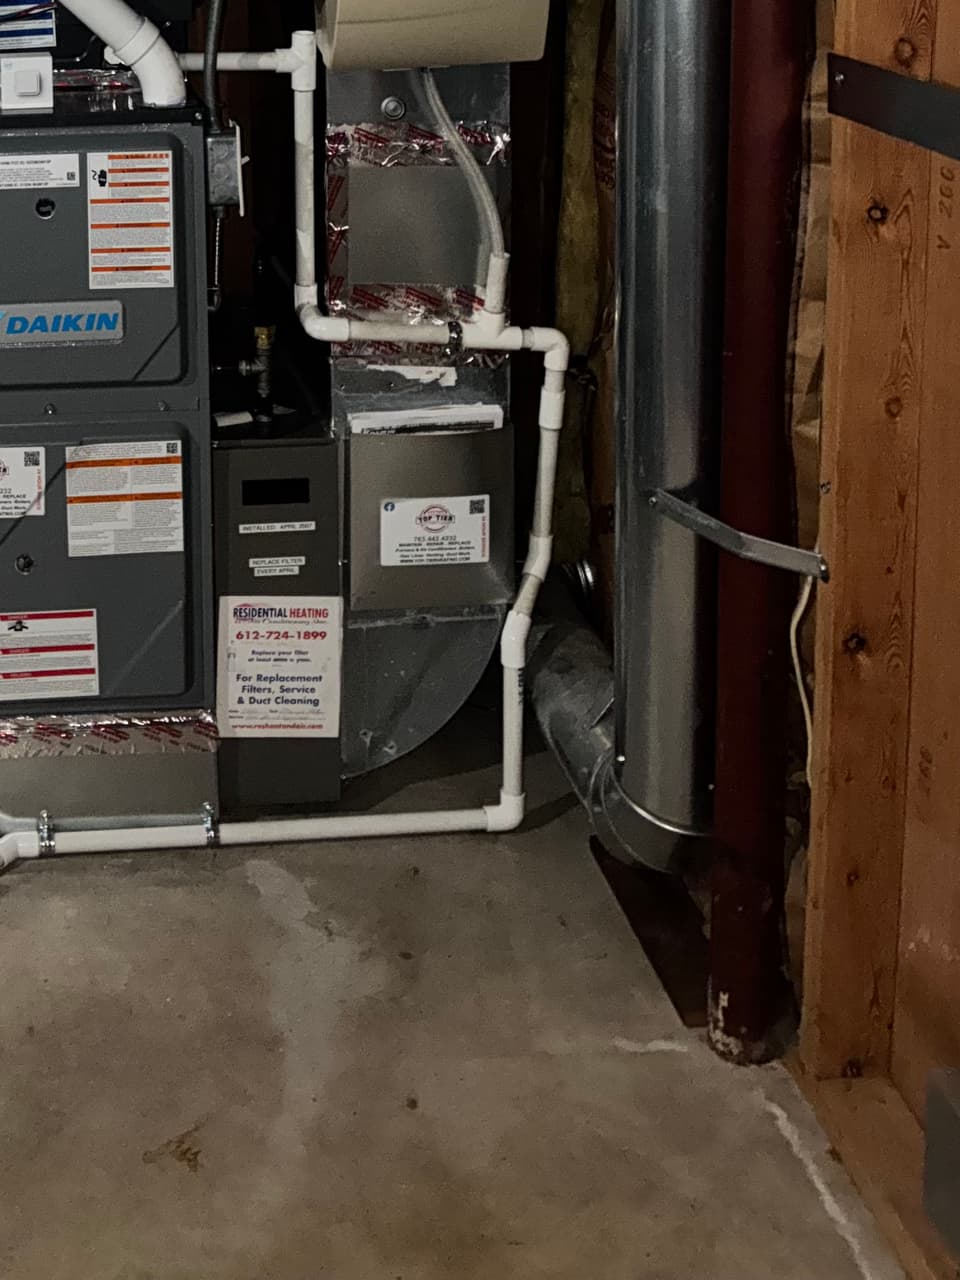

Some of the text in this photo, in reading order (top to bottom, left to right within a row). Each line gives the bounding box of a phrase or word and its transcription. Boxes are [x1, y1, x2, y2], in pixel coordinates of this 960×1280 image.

[6, 312, 120, 335] DAIKIN
[233, 608, 328, 618] RESIDENTIAL HEATING
[236, 630, 327, 640] 612-724-1899
[236, 674, 322, 684] For Replacement
[241, 685, 316, 694] Filters, Service
[237, 696, 320, 707] & Duct Cleaning
